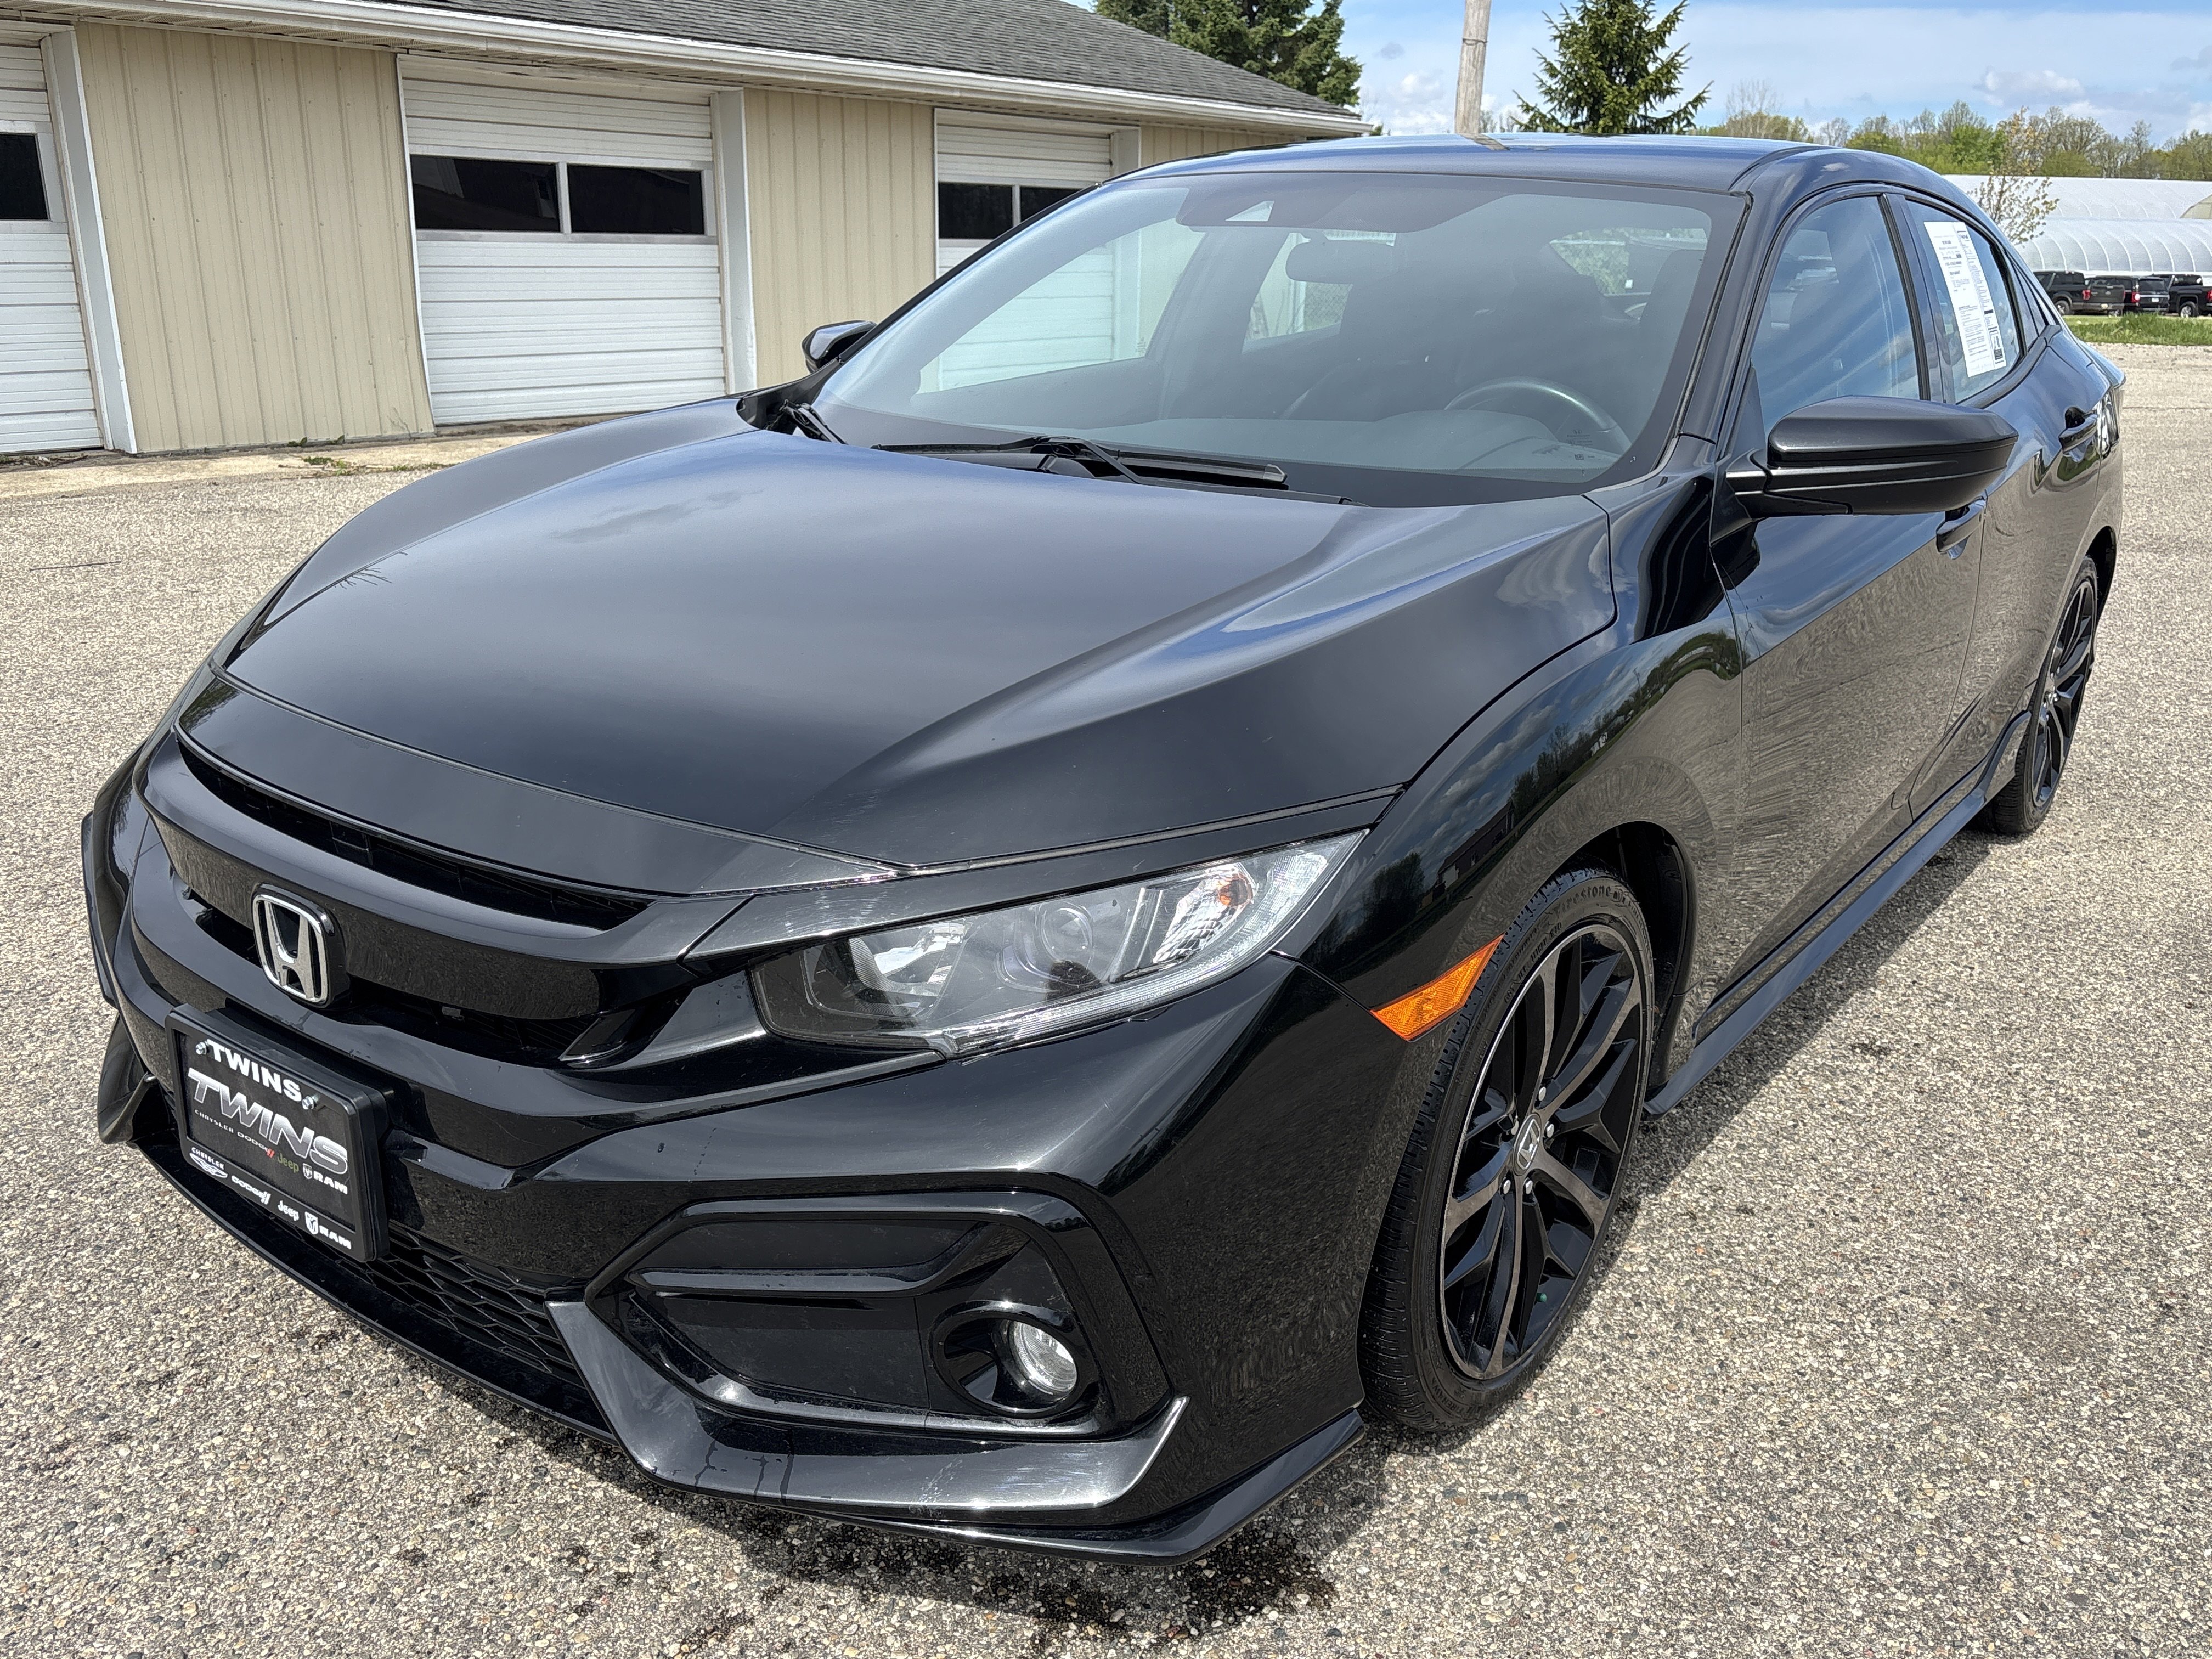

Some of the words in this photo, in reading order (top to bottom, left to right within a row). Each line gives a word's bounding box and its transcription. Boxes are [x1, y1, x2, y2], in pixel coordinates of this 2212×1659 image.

[1553, 885, 1612, 921] Firestone
[207, 1039, 302, 1102] TWINS
[188, 1067, 348, 1175] TWINS
[195, 1109, 234, 1133] CHRYSLER
[277, 1153, 300, 1173] Jeep
[313, 1171, 348, 1194] RAM
[192, 1147, 225, 1170] CHRYSLER
[278, 1200, 300, 1221] Jeep
[319, 1225, 352, 1250] RAM
